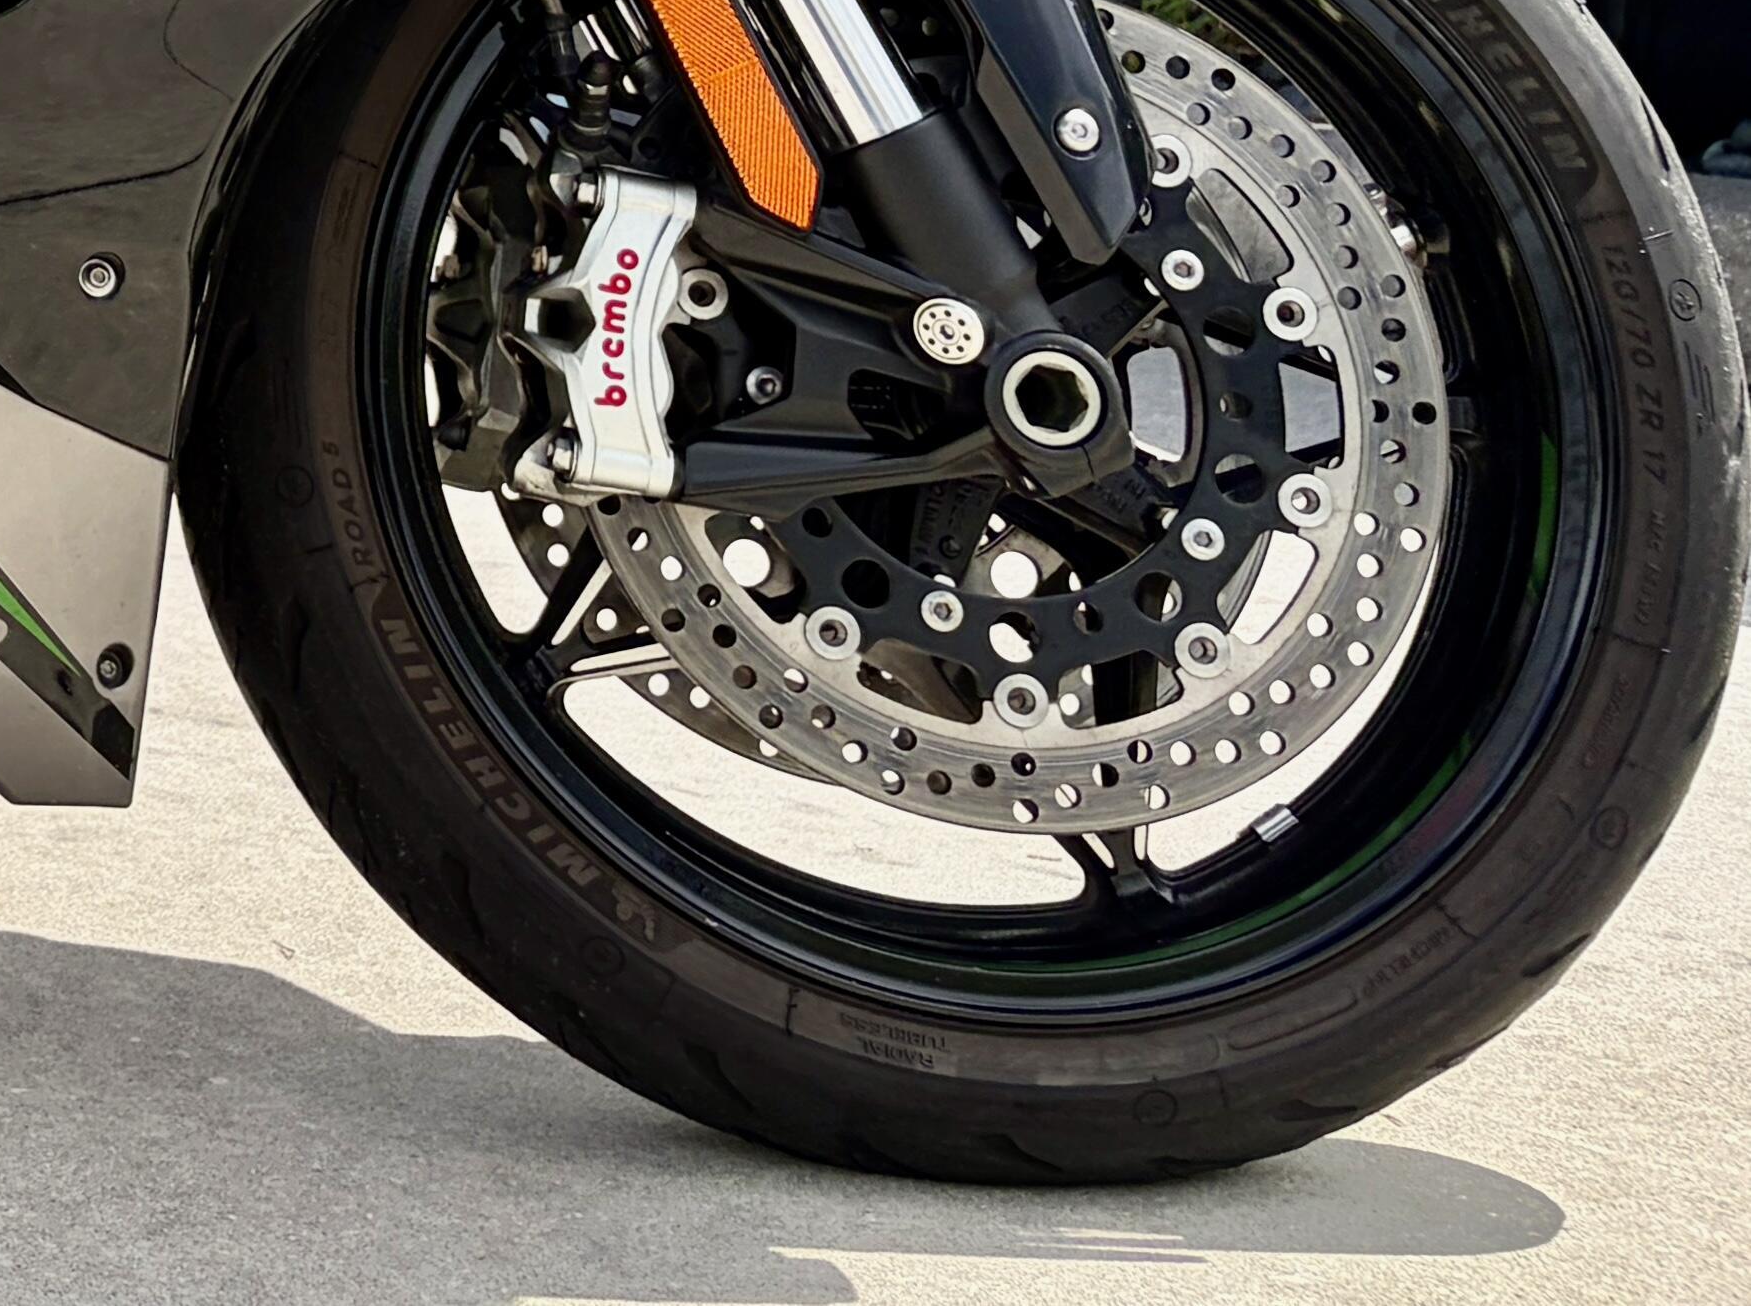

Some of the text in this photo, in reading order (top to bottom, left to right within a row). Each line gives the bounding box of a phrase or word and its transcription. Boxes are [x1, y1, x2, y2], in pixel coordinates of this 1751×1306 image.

[594, 248, 639, 408] brembo
[1635, 387, 1665, 436] ZR
[332, 468, 374, 568] ROAD
[1642, 452, 1667, 487] 17
[379, 618, 600, 887] MICHELIN
